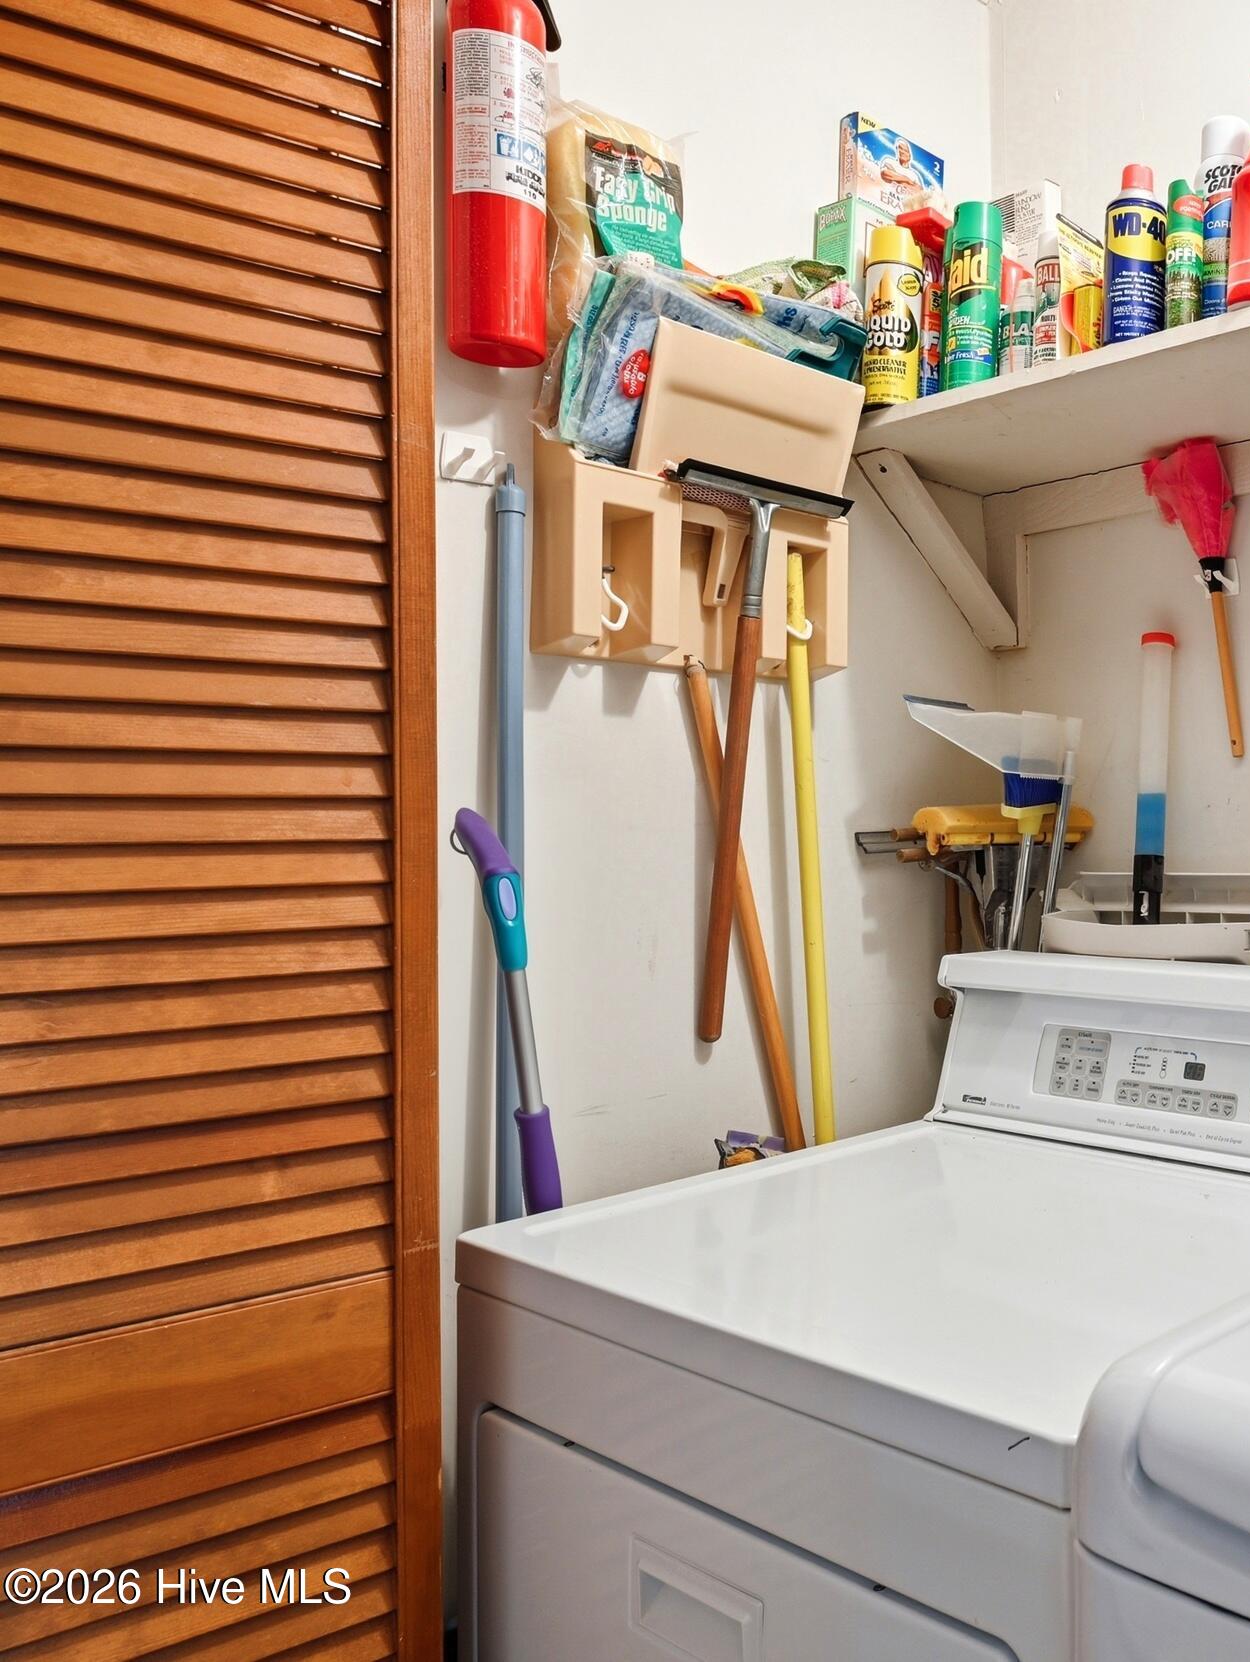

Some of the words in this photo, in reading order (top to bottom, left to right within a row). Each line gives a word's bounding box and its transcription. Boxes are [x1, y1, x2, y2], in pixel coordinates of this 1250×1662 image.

[593, 165, 639, 204] Easy
[597, 194, 667, 232] Sponge
[1112, 212, 1165, 245] WD-40
[949, 247, 988, 291] aid
[1037, 265, 1060, 287] BALL
[865, 330, 906, 349] GOLD
[867, 314, 912, 333] IQUID
